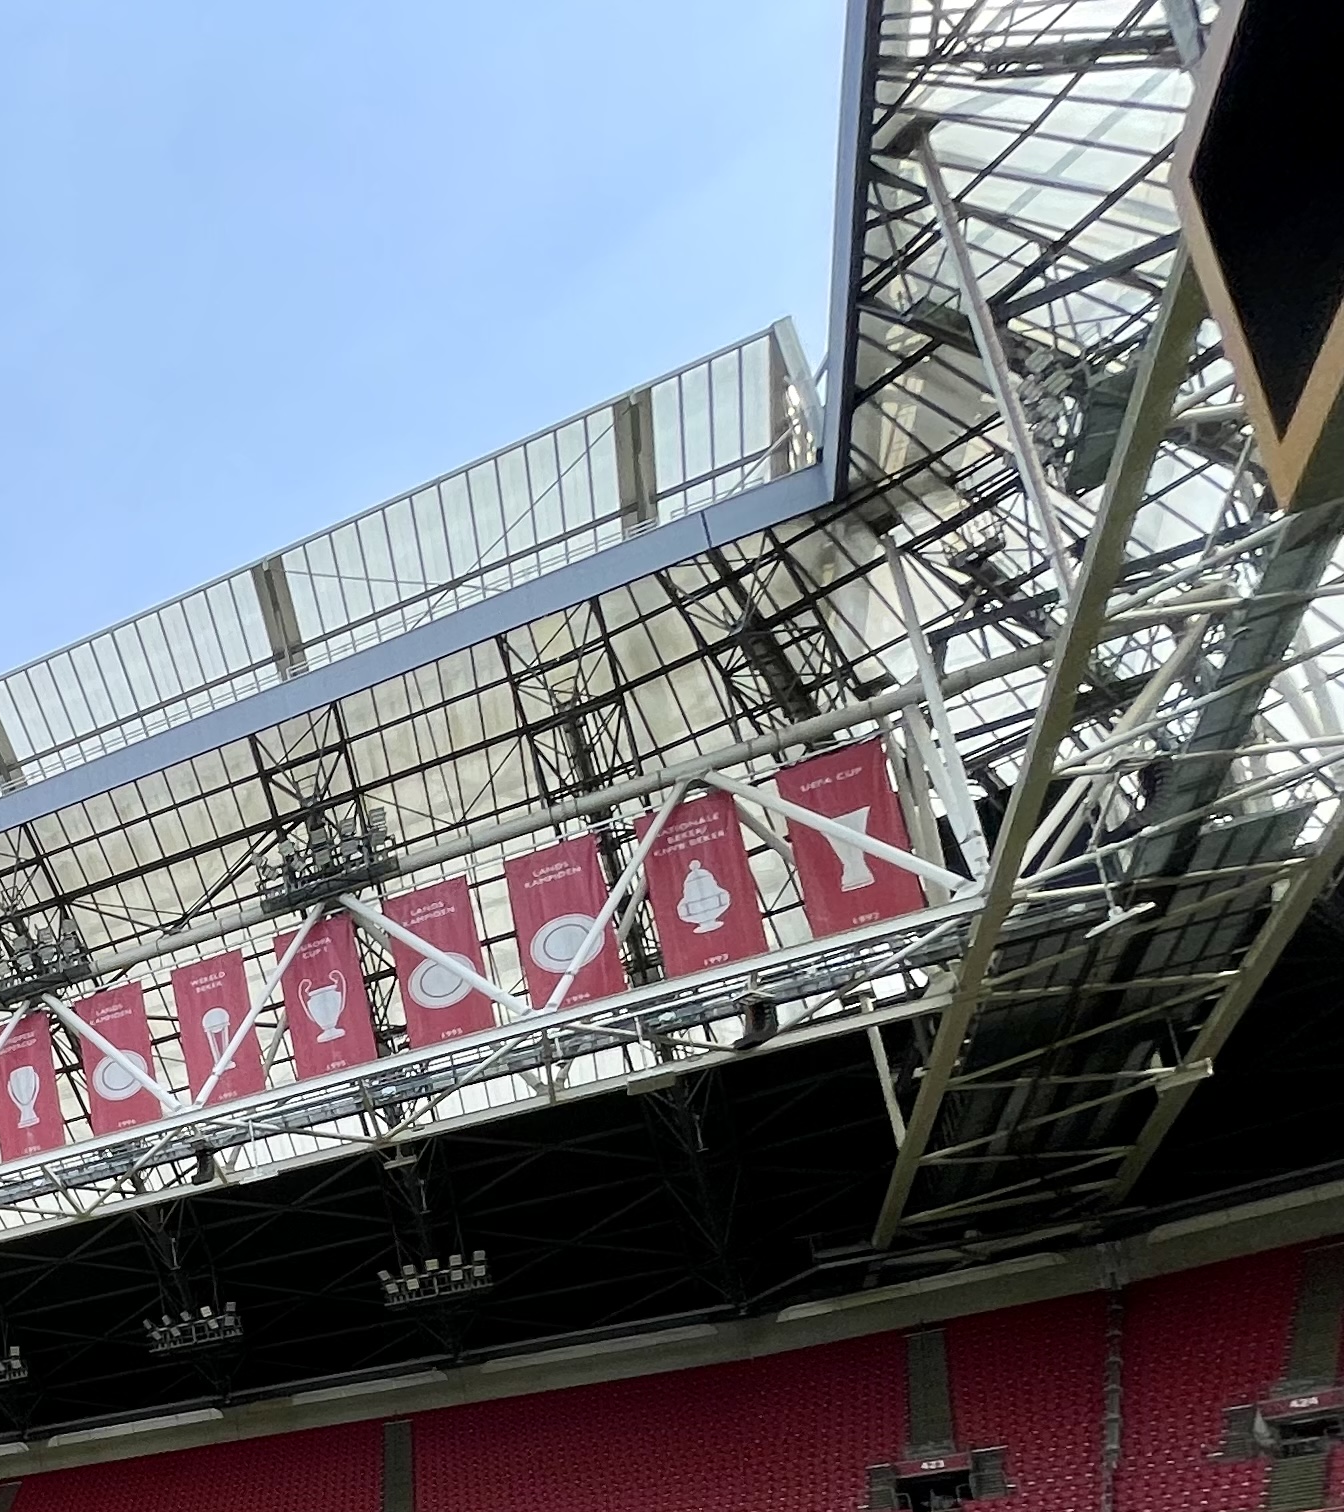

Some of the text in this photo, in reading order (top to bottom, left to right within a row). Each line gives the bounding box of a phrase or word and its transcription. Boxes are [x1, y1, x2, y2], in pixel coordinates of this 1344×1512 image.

[800, 767, 862, 793] UEFA CUP
[656, 811, 720, 837] ATIONALE
[532, 860, 569, 878] LANDS
[411, 900, 445, 916] LANDS
[703, 953, 729, 966] 1993
[920, 1460, 946, 1470] 423
